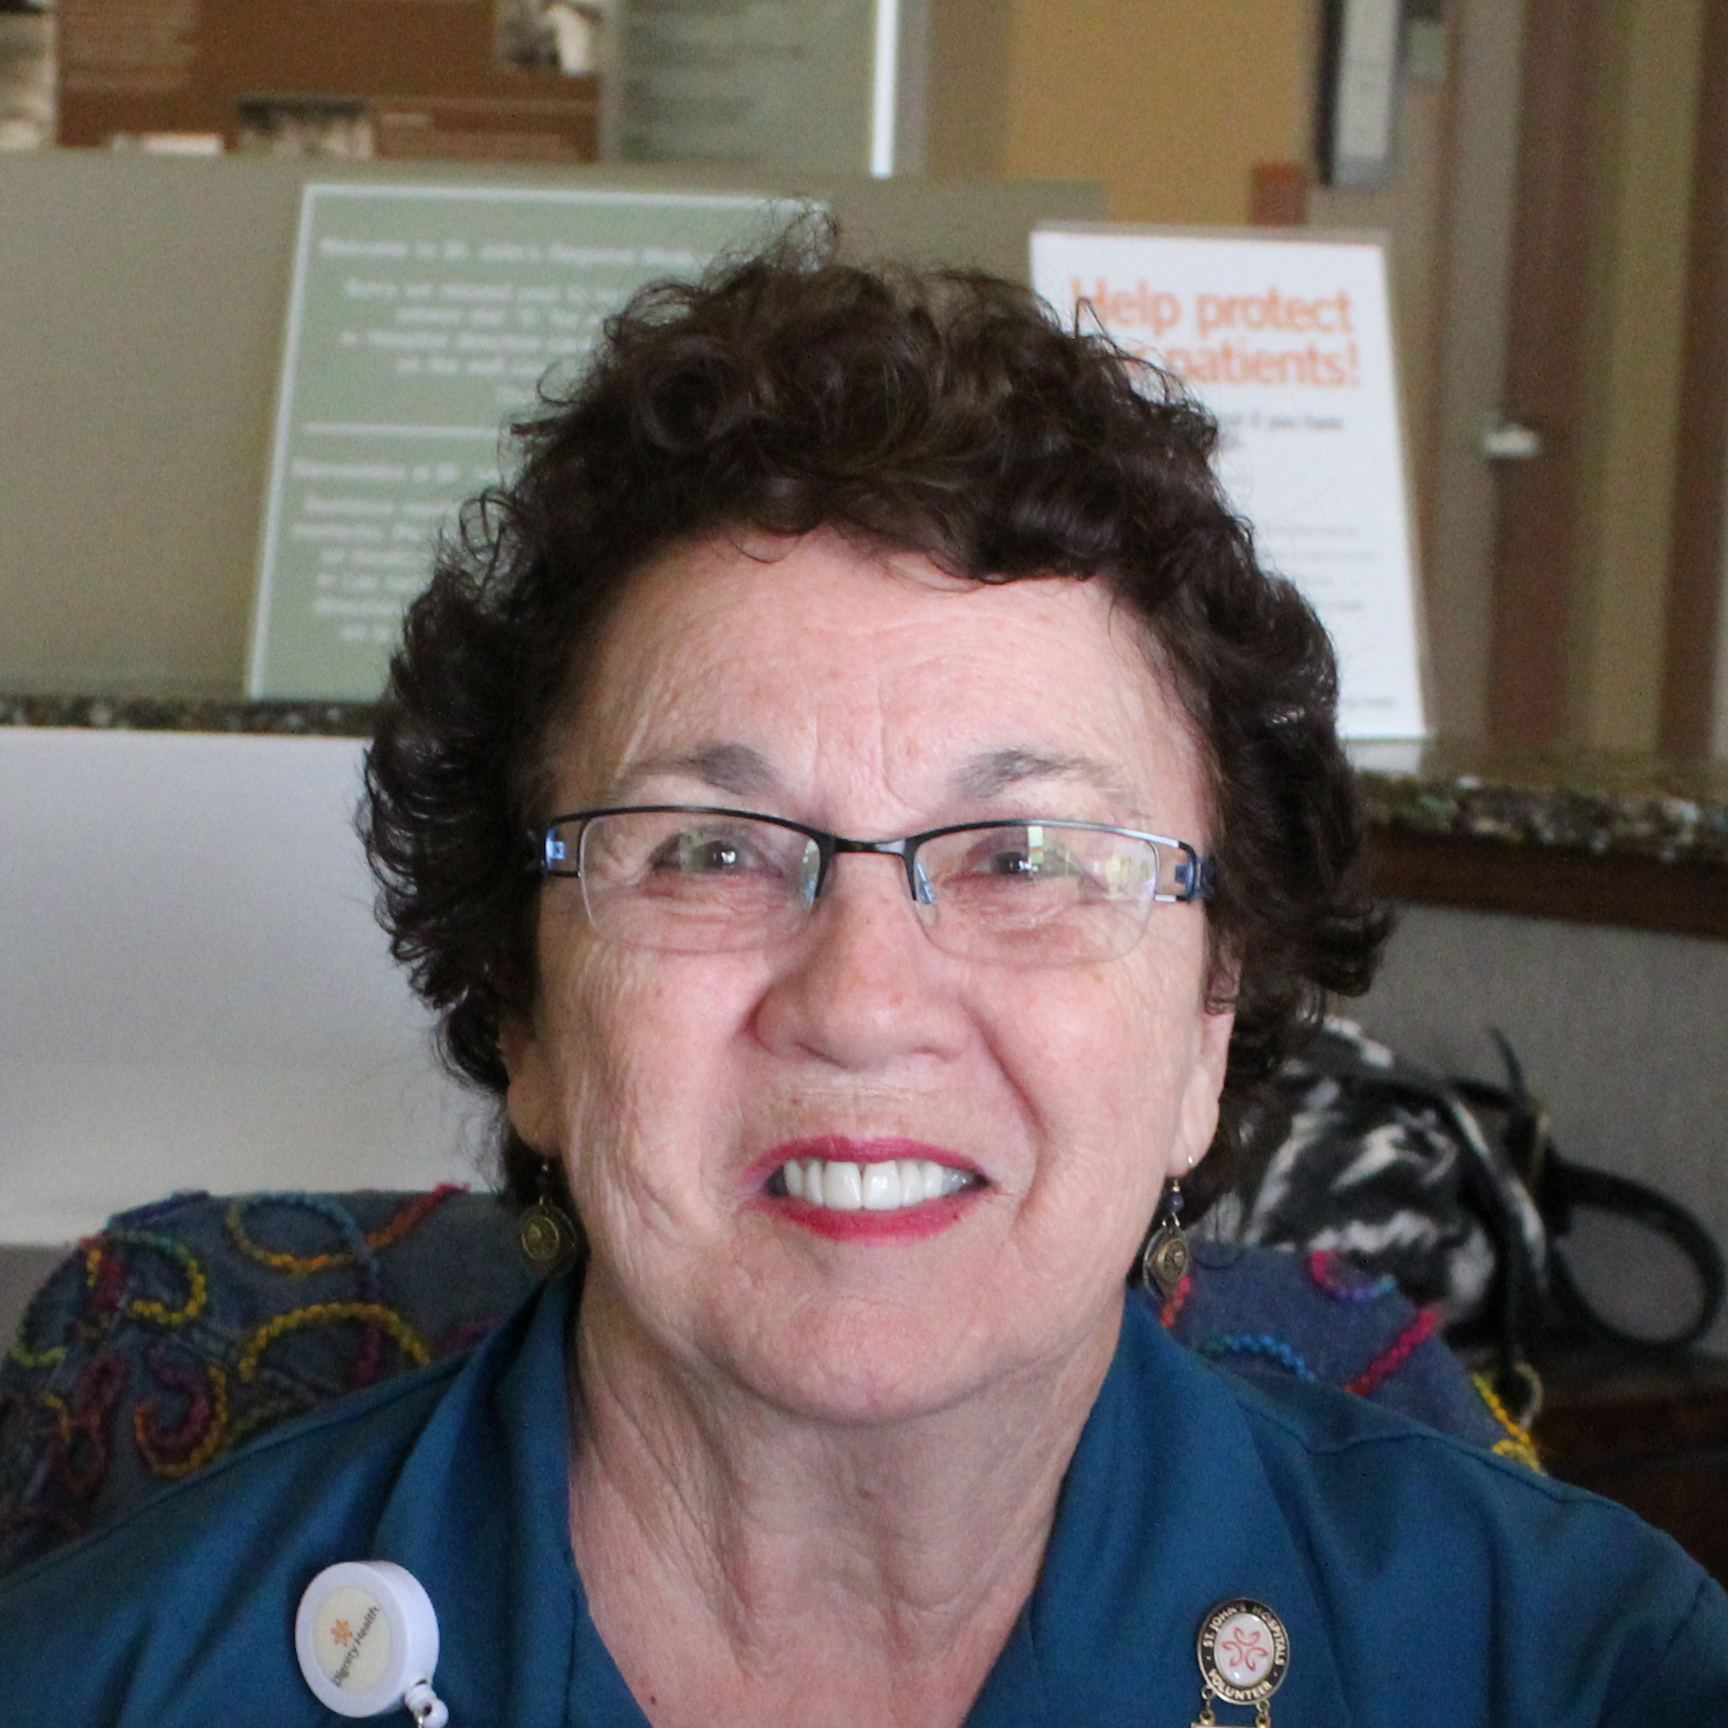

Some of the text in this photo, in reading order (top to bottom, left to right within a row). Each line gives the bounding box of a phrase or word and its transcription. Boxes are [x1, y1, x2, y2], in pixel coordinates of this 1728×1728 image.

[1072, 277, 1354, 338] Help protect
[1165, 341, 1362, 388] patients!
[1208, 1668, 1273, 1700] VOLUNTEER
